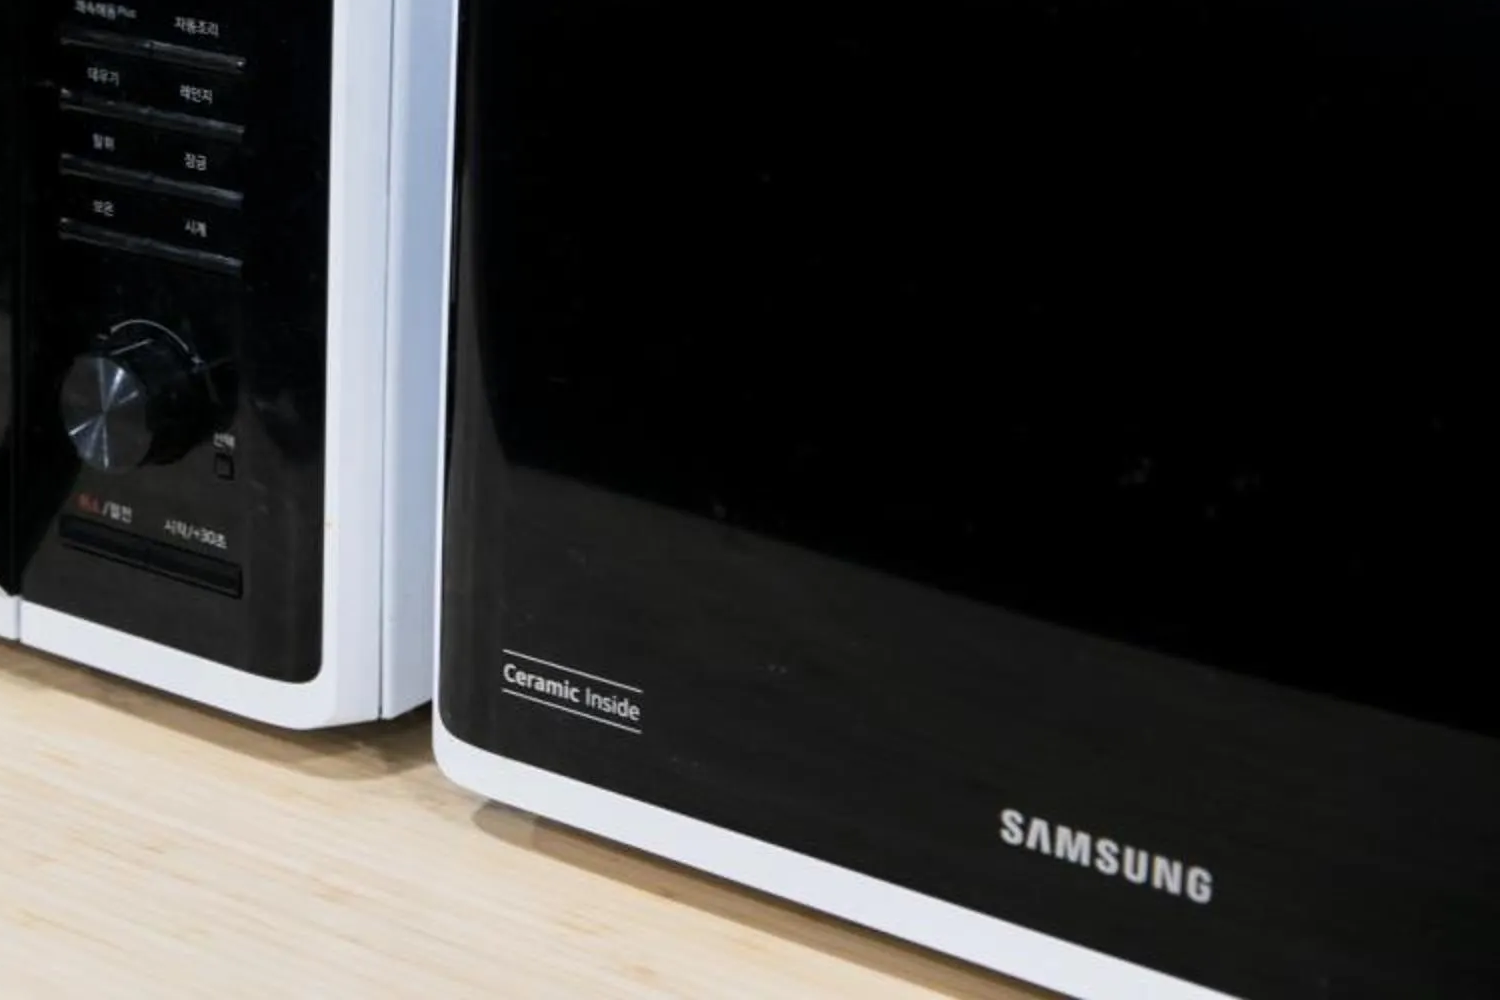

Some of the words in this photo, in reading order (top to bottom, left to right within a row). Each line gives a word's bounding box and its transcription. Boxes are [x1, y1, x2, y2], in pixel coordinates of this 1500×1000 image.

[503, 663, 581, 703] Ceramic
[585, 687, 641, 722] Inside
[1000, 808, 1213, 904] SAMSUNG
